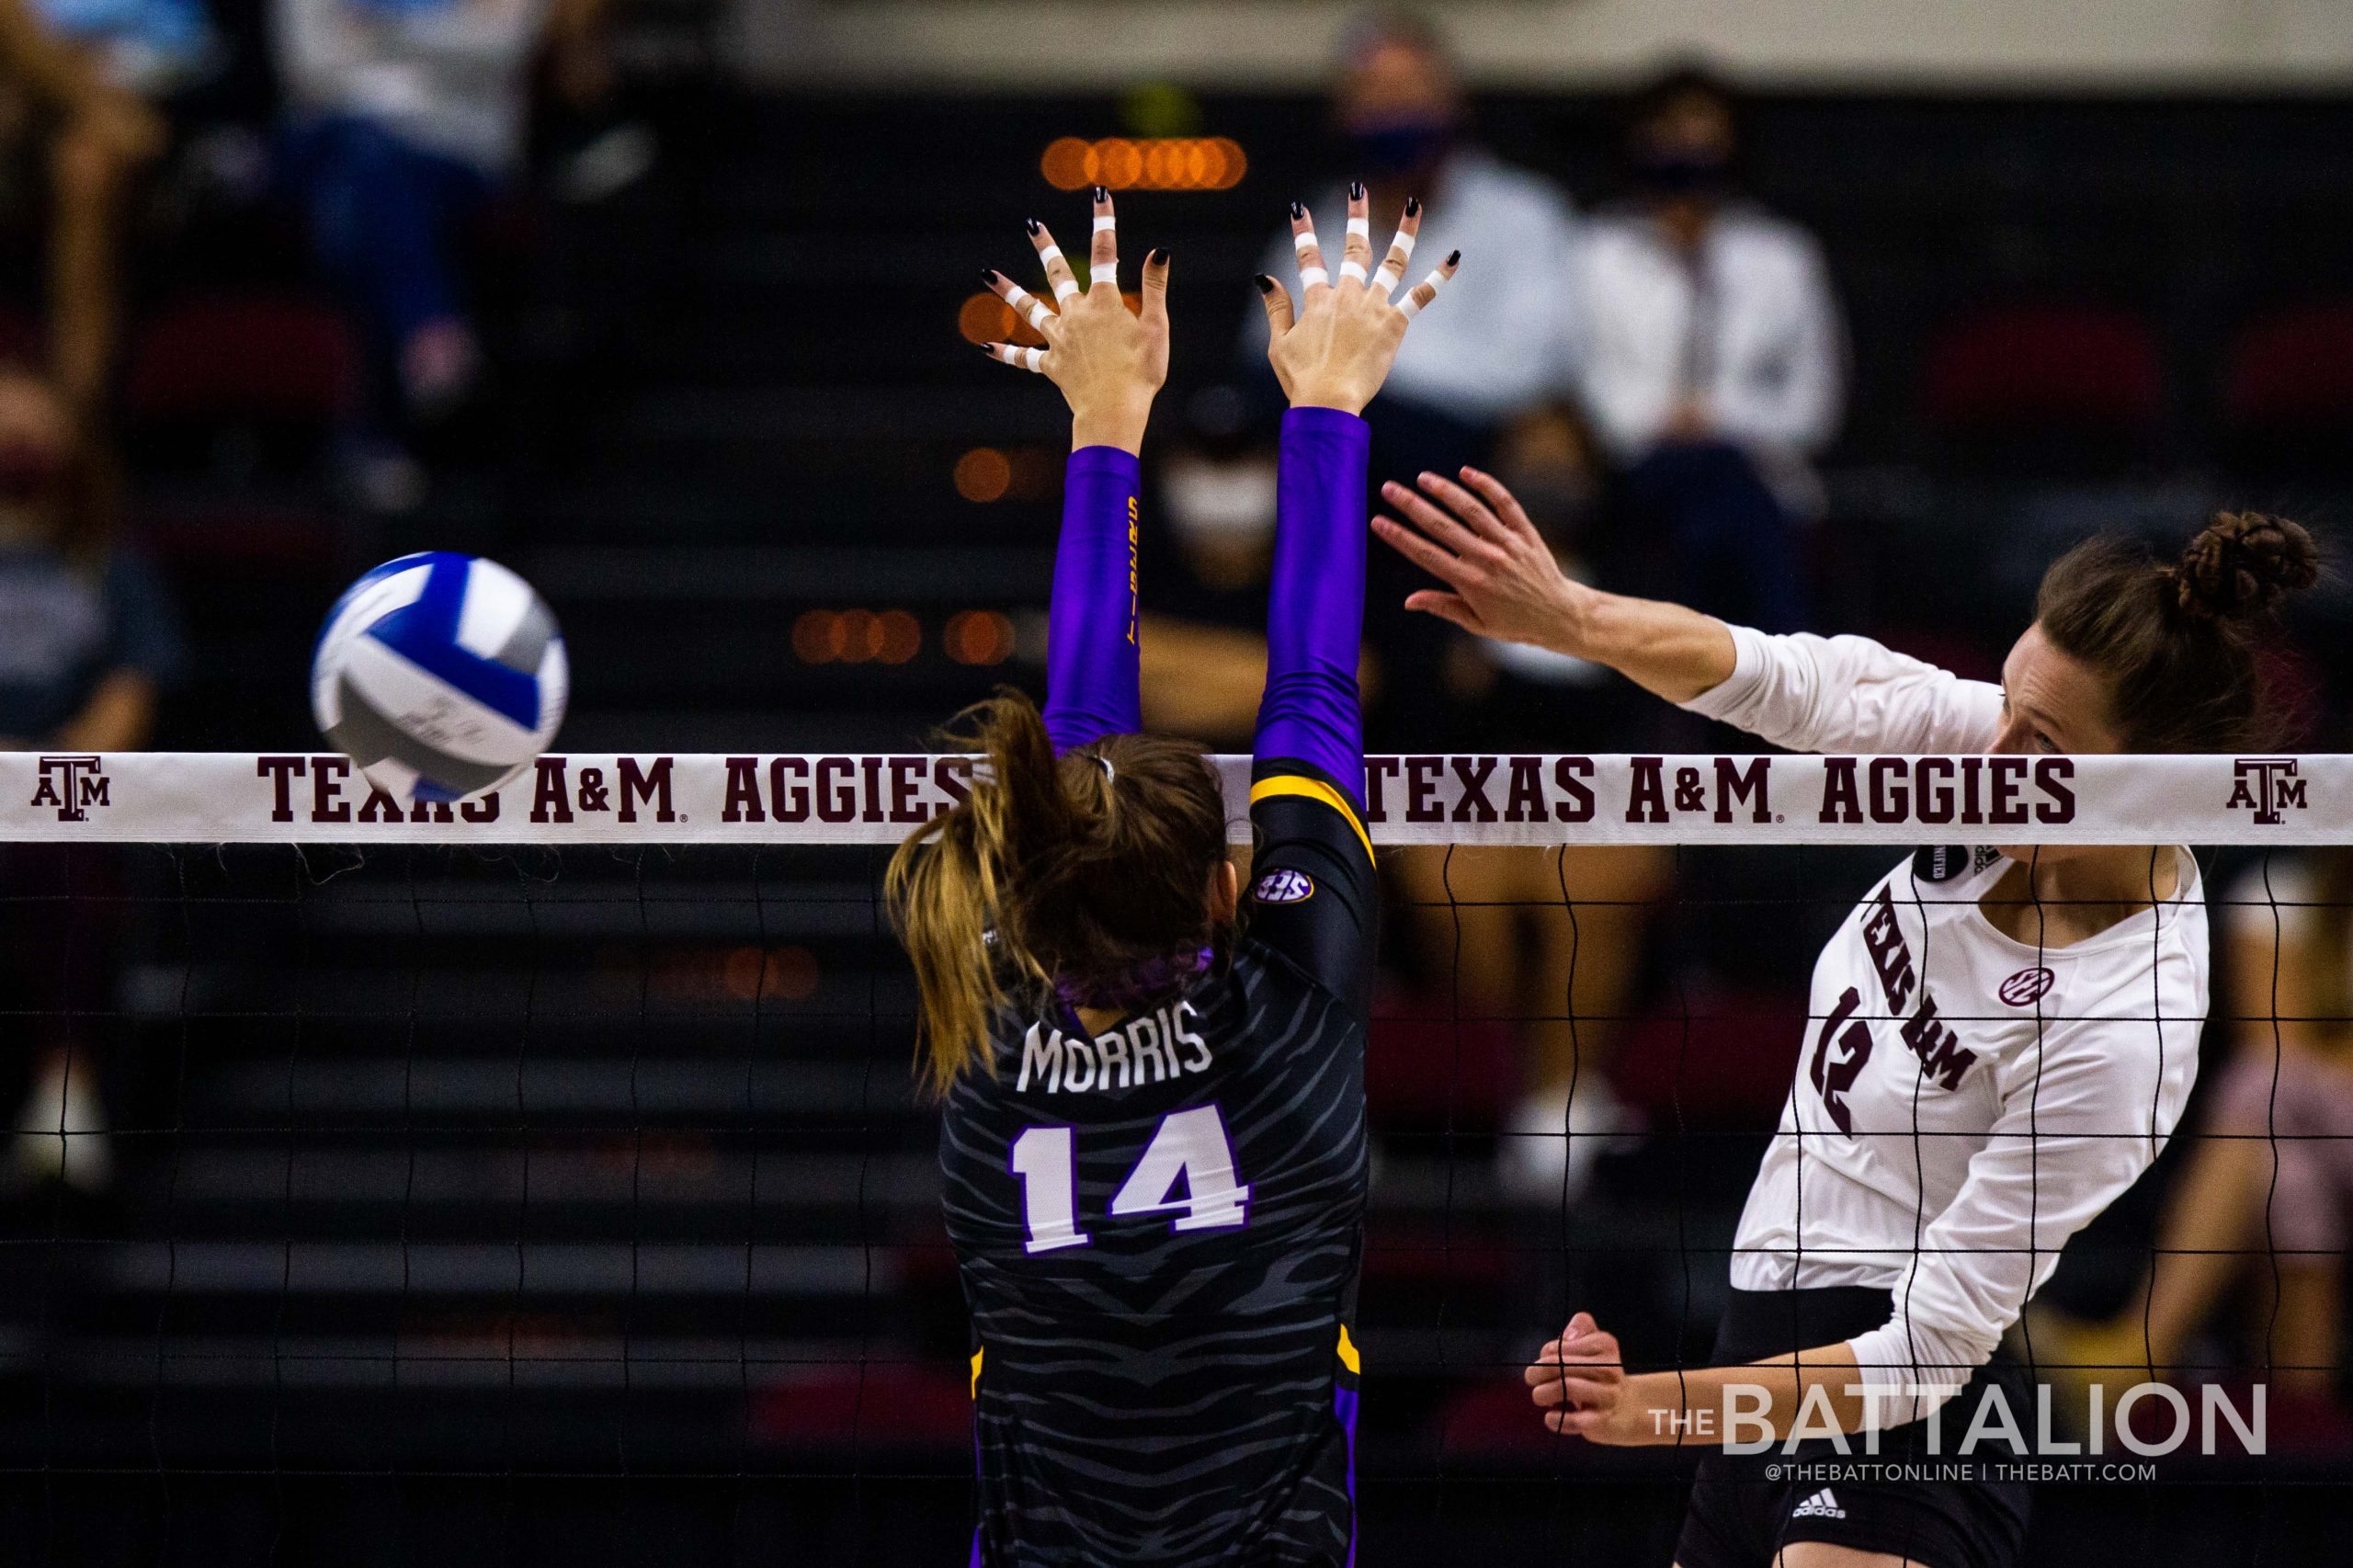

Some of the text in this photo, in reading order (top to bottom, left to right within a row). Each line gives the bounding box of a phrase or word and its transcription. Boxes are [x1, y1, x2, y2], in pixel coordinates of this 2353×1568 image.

[722, 756, 972, 824] AGGIES
[1364, 756, 1595, 823] TEXAS
[1819, 757, 2075, 824] AGGIES
[1017, 1000, 1212, 1094] MORRIS
[1810, 986, 1873, 1141] 12
[1010, 1102, 1251, 1255] 14
[1792, 1506, 1846, 1519] adidas
